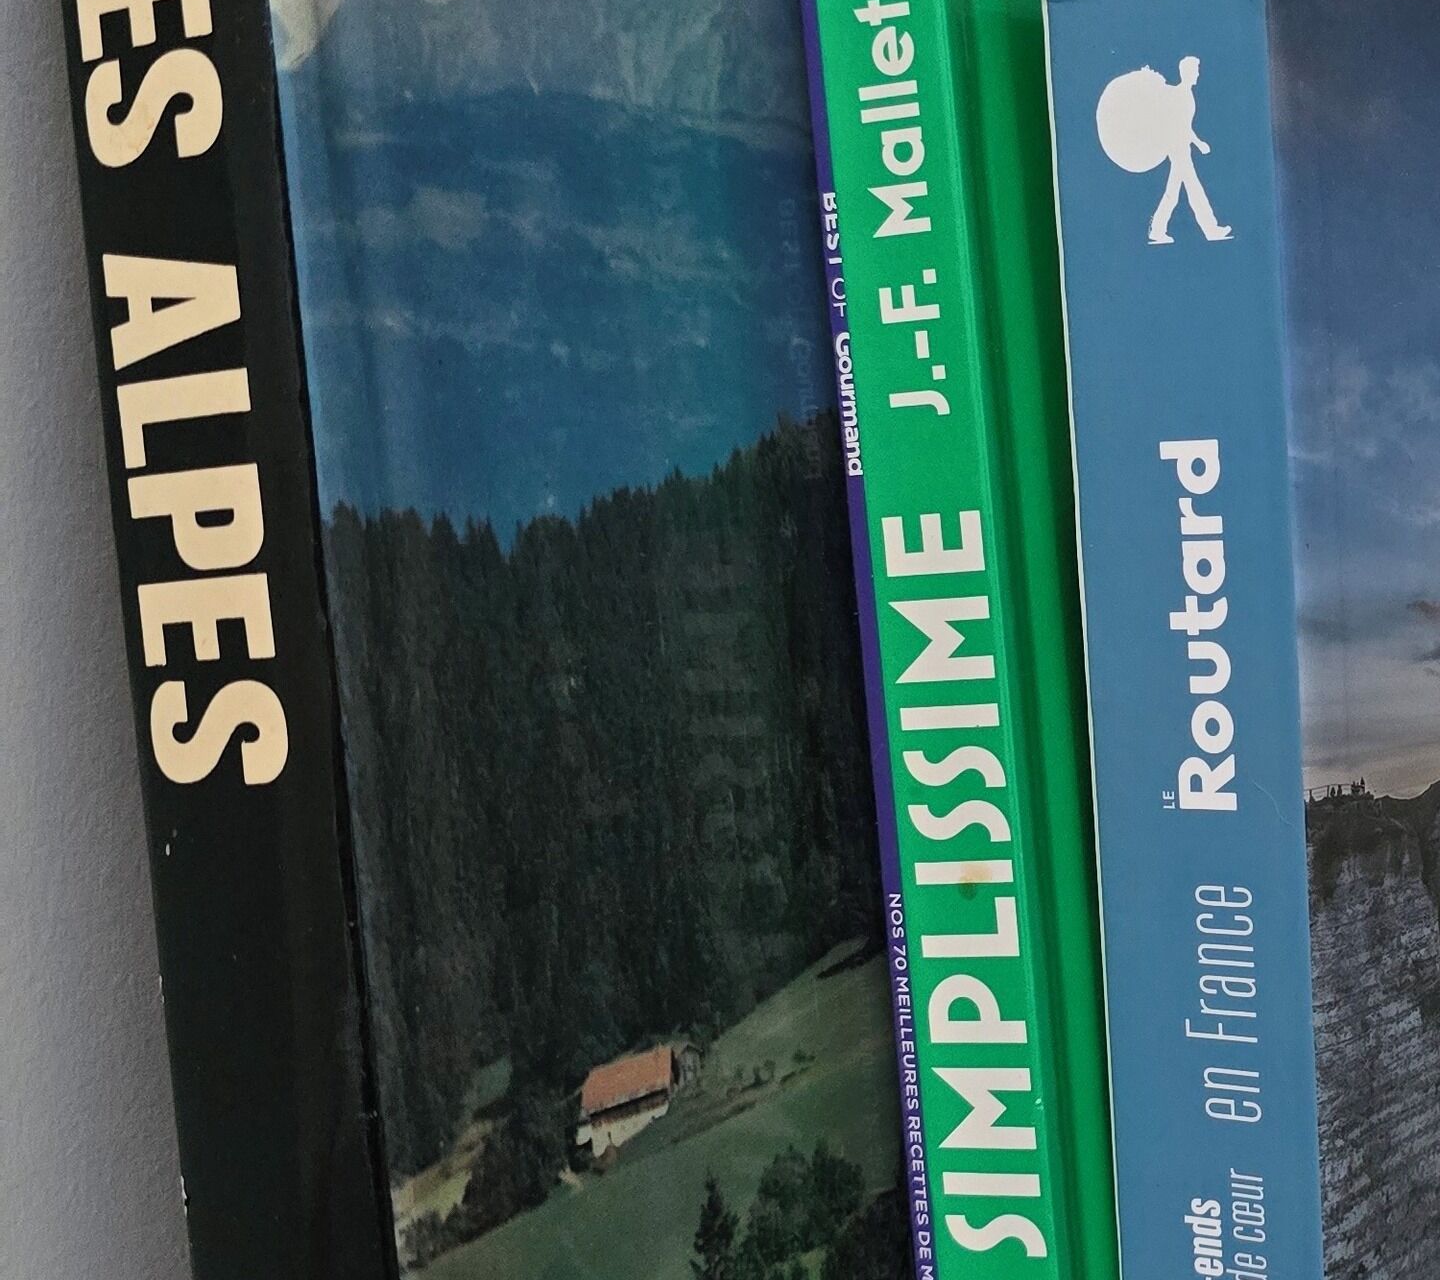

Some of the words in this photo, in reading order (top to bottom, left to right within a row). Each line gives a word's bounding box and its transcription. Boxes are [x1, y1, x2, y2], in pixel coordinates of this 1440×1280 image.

[878, 269, 951, 416] J.-F.
[835, 331, 864, 477] Gourmand
[102, 252, 289, 786] ALPES
[1158, 438, 1239, 812] Routard
[1162, 790, 1176, 810] LE
[881, 509, 1048, 1260] SIMPLISSIME
[888, 892, 905, 939] NOS
[893, 945, 907, 971] 70
[1185, 883, 1256, 1045] France
[896, 976, 919, 1110] MEILLEURES
[1203, 1068, 1263, 1125] en
[907, 1115, 929, 1226] RECETTES
[1228, 1168, 1264, 1229] cœur
[917, 1231, 932, 1259] DE
